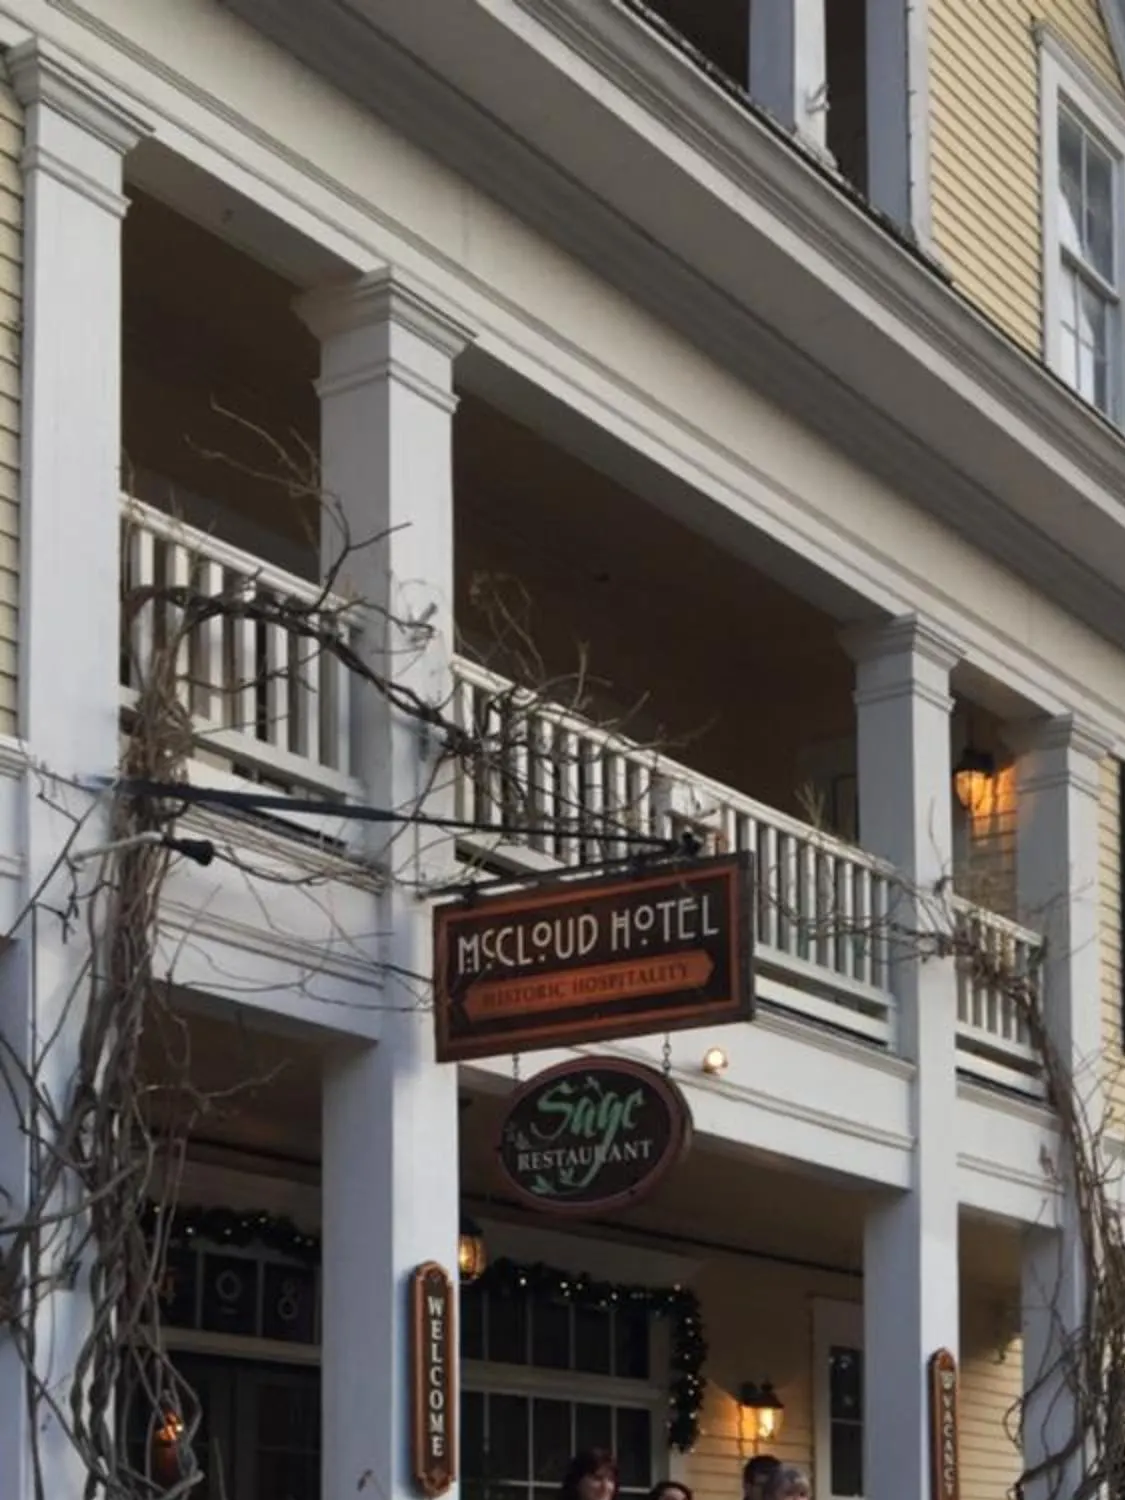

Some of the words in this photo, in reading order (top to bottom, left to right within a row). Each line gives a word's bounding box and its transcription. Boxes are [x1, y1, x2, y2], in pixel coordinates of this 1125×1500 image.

[610, 894, 719, 950] HOTEL
[481, 983, 564, 1008] HISTORIC
[571, 962, 689, 996] HOSPITALITY
[518, 1140, 652, 1171] RESTAURANT
[530, 1080, 644, 1188] Sage
[427, 1296, 445, 1457] WELCOME
[943, 1395, 954, 1496] VACANCY
